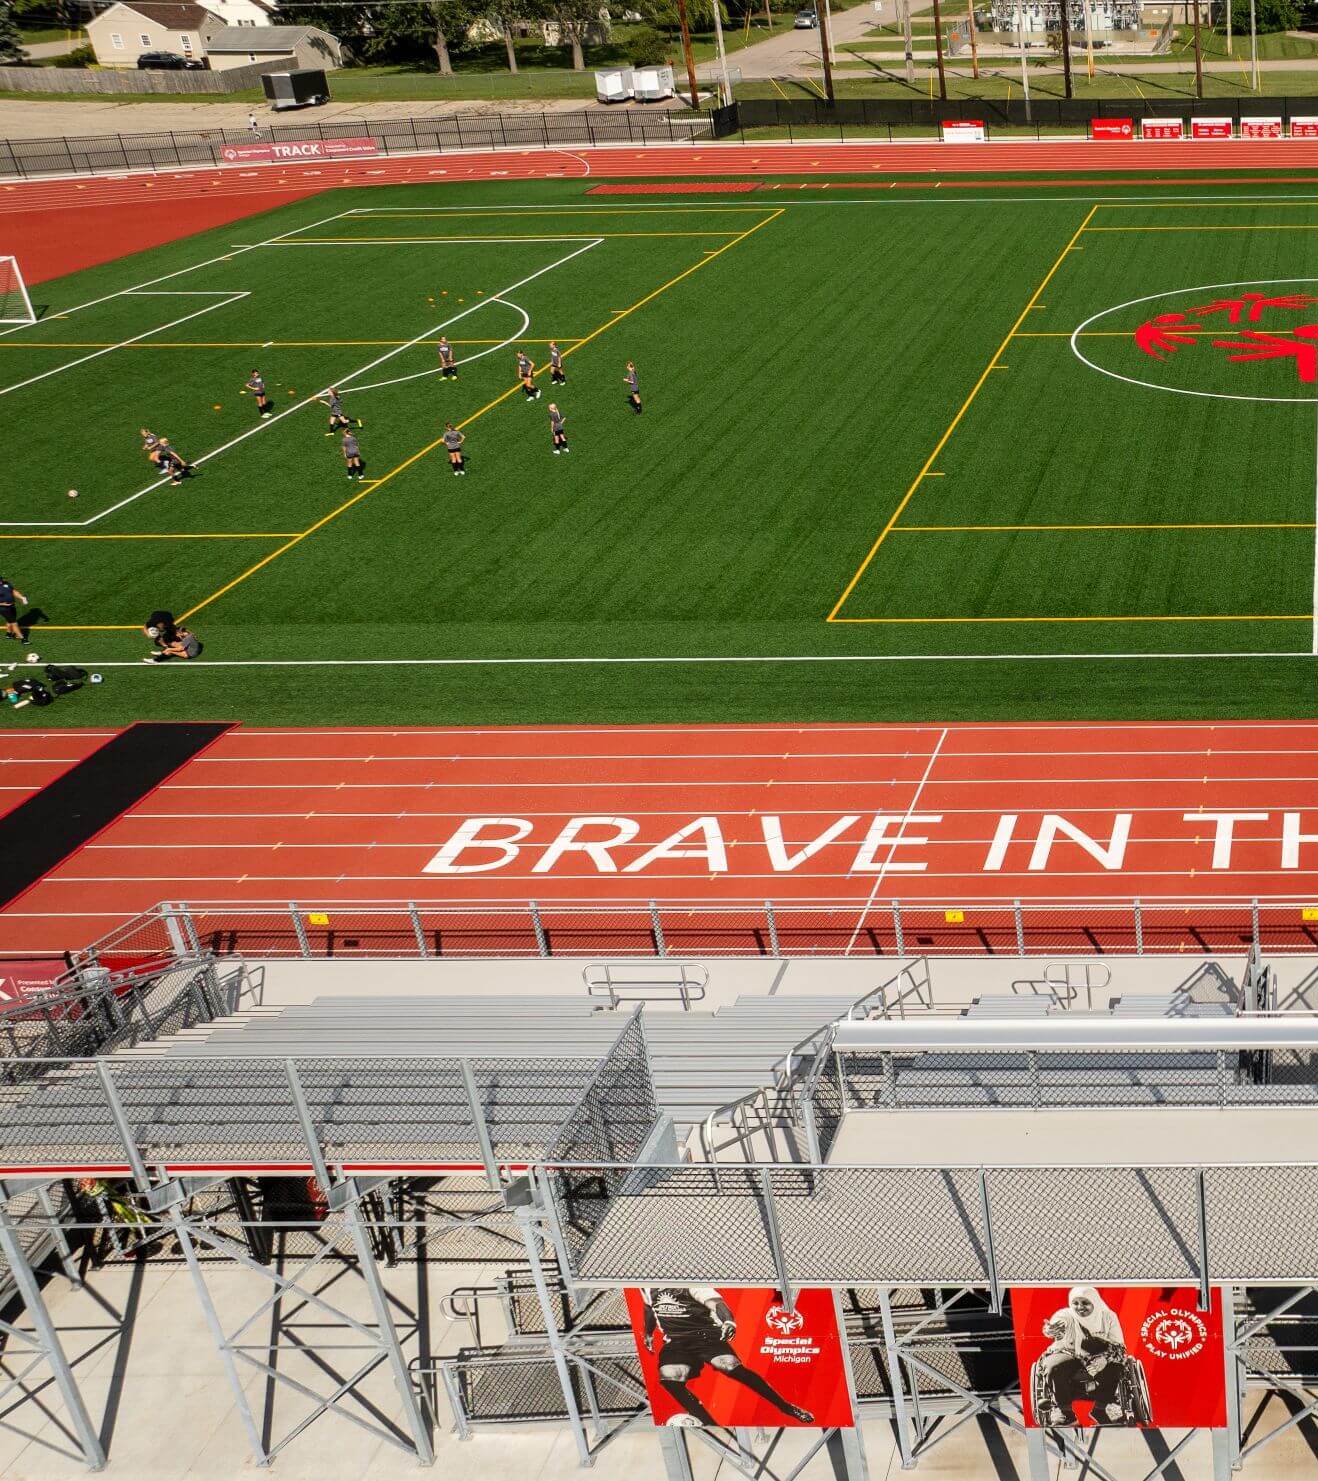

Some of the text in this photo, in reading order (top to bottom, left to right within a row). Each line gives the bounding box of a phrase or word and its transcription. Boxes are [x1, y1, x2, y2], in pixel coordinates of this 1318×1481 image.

[272, 144, 321, 157] TRACK
[421, 815, 943, 873] BRAVE
[983, 813, 1132, 870] IN
[1141, 1308, 1207, 1337] SPECIAL OLYMPICS
[764, 1337, 812, 1346] Special
[760, 1346, 820, 1355] Olympics
[1145, 1343, 1203, 1360] PLAY UNIFIED
[773, 1355, 811, 1363] Michigan
